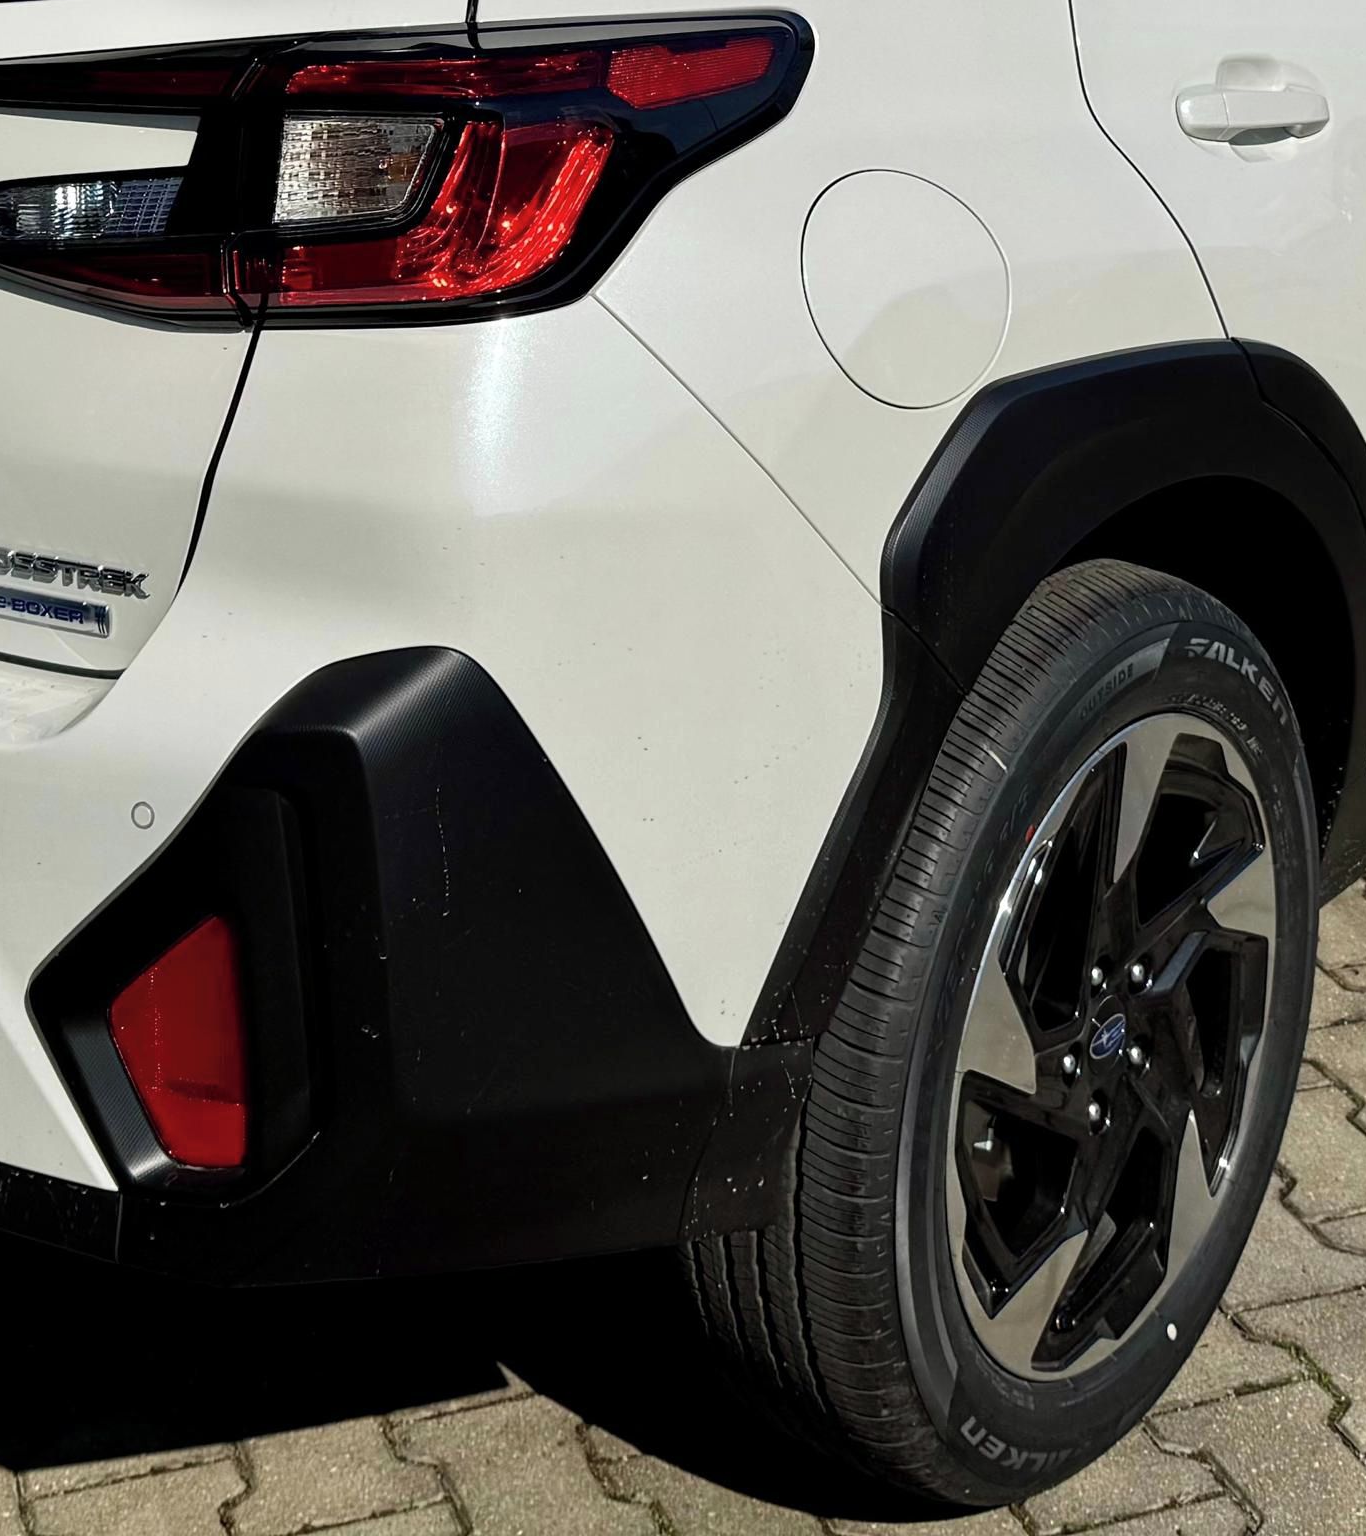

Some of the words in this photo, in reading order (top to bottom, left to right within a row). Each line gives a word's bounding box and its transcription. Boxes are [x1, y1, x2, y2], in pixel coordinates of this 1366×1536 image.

[1080, 662, 1134, 720] OUTSIDE
[1184, 637, 1288, 726] FALKEN
[959, 1415, 1083, 1473] ALKEN
